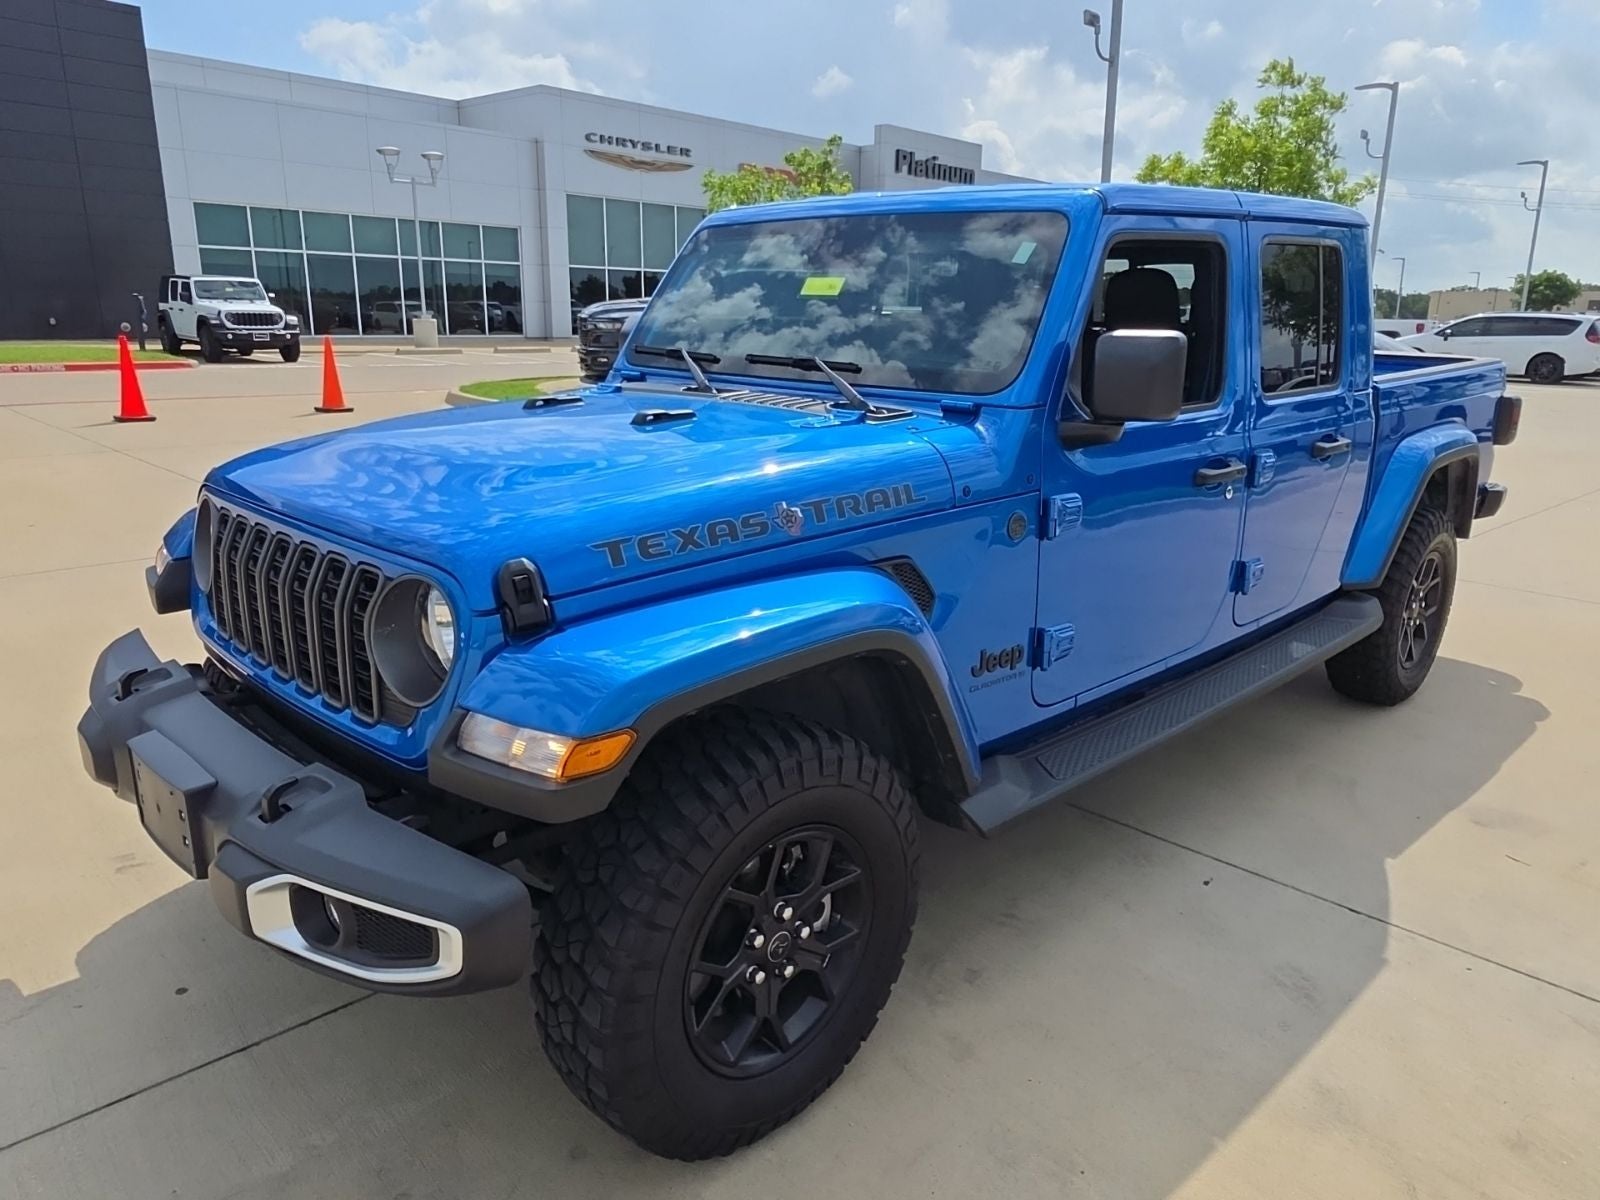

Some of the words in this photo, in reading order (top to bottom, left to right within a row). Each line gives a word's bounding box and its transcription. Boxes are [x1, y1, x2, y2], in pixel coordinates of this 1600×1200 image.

[584, 132, 693, 157] CHRYSLER
[895, 149, 975, 185] Platinum
[588, 511, 771, 568] TEXAS
[801, 483, 926, 524] TRAIL
[970, 644, 1025, 678] Jeep
